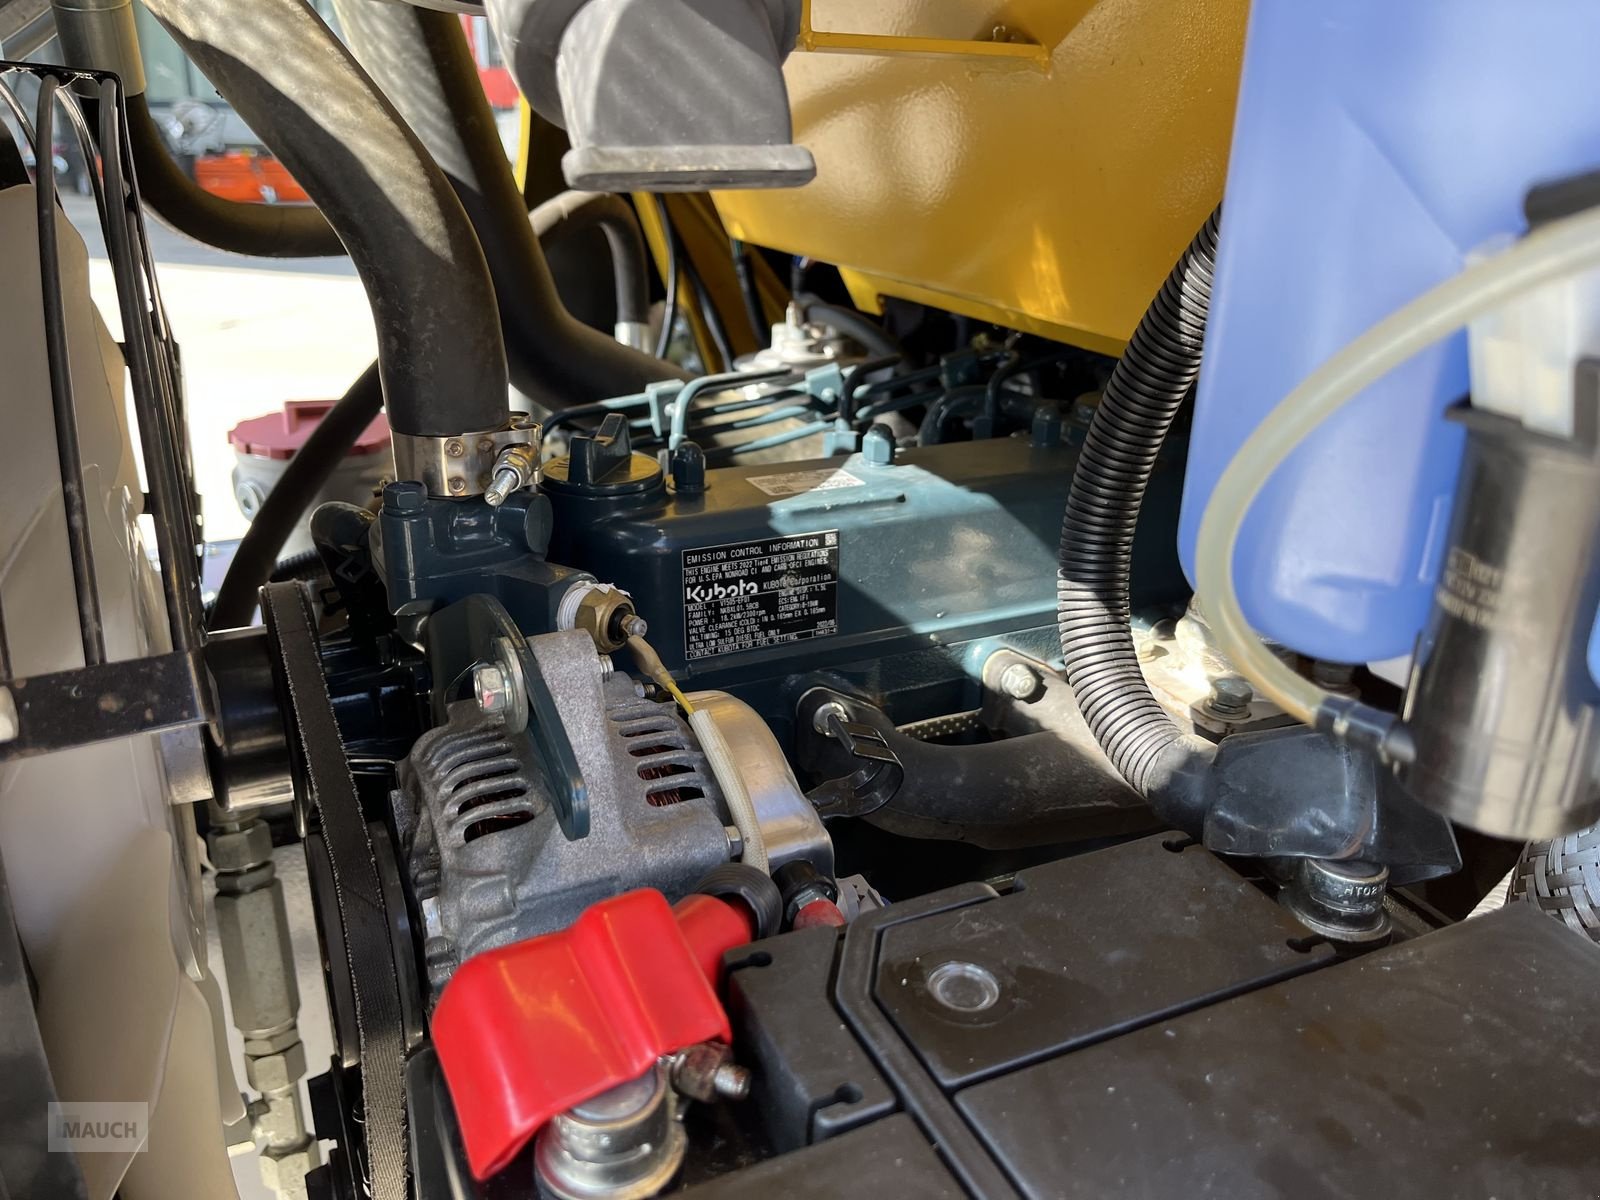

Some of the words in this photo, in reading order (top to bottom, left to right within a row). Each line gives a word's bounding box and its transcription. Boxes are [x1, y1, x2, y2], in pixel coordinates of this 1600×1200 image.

[687, 552, 726, 564] EMISSION
[731, 546, 763, 557] CONTROL
[769, 539, 819, 552] INFORMATION
[701, 566, 720, 574] ENGINE
[771, 555, 795, 564] EMISSION
[796, 550, 829, 560] REGULATIONS
[725, 569, 749, 578] NONROAD
[686, 579, 758, 602] Kubota
[763, 580, 787, 590] KUBOTA
[688, 603, 707, 612] MODEL
[688, 618, 709, 627] POWER
[688, 626, 706, 634] VALVE
[709, 621, 738, 631] CLEARANCE
[717, 636, 734, 645] SULFUR
[736, 633, 752, 641] DIESEL
[690, 648, 715, 658] CONTACT
[718, 644, 740, 653] KUBOTA
